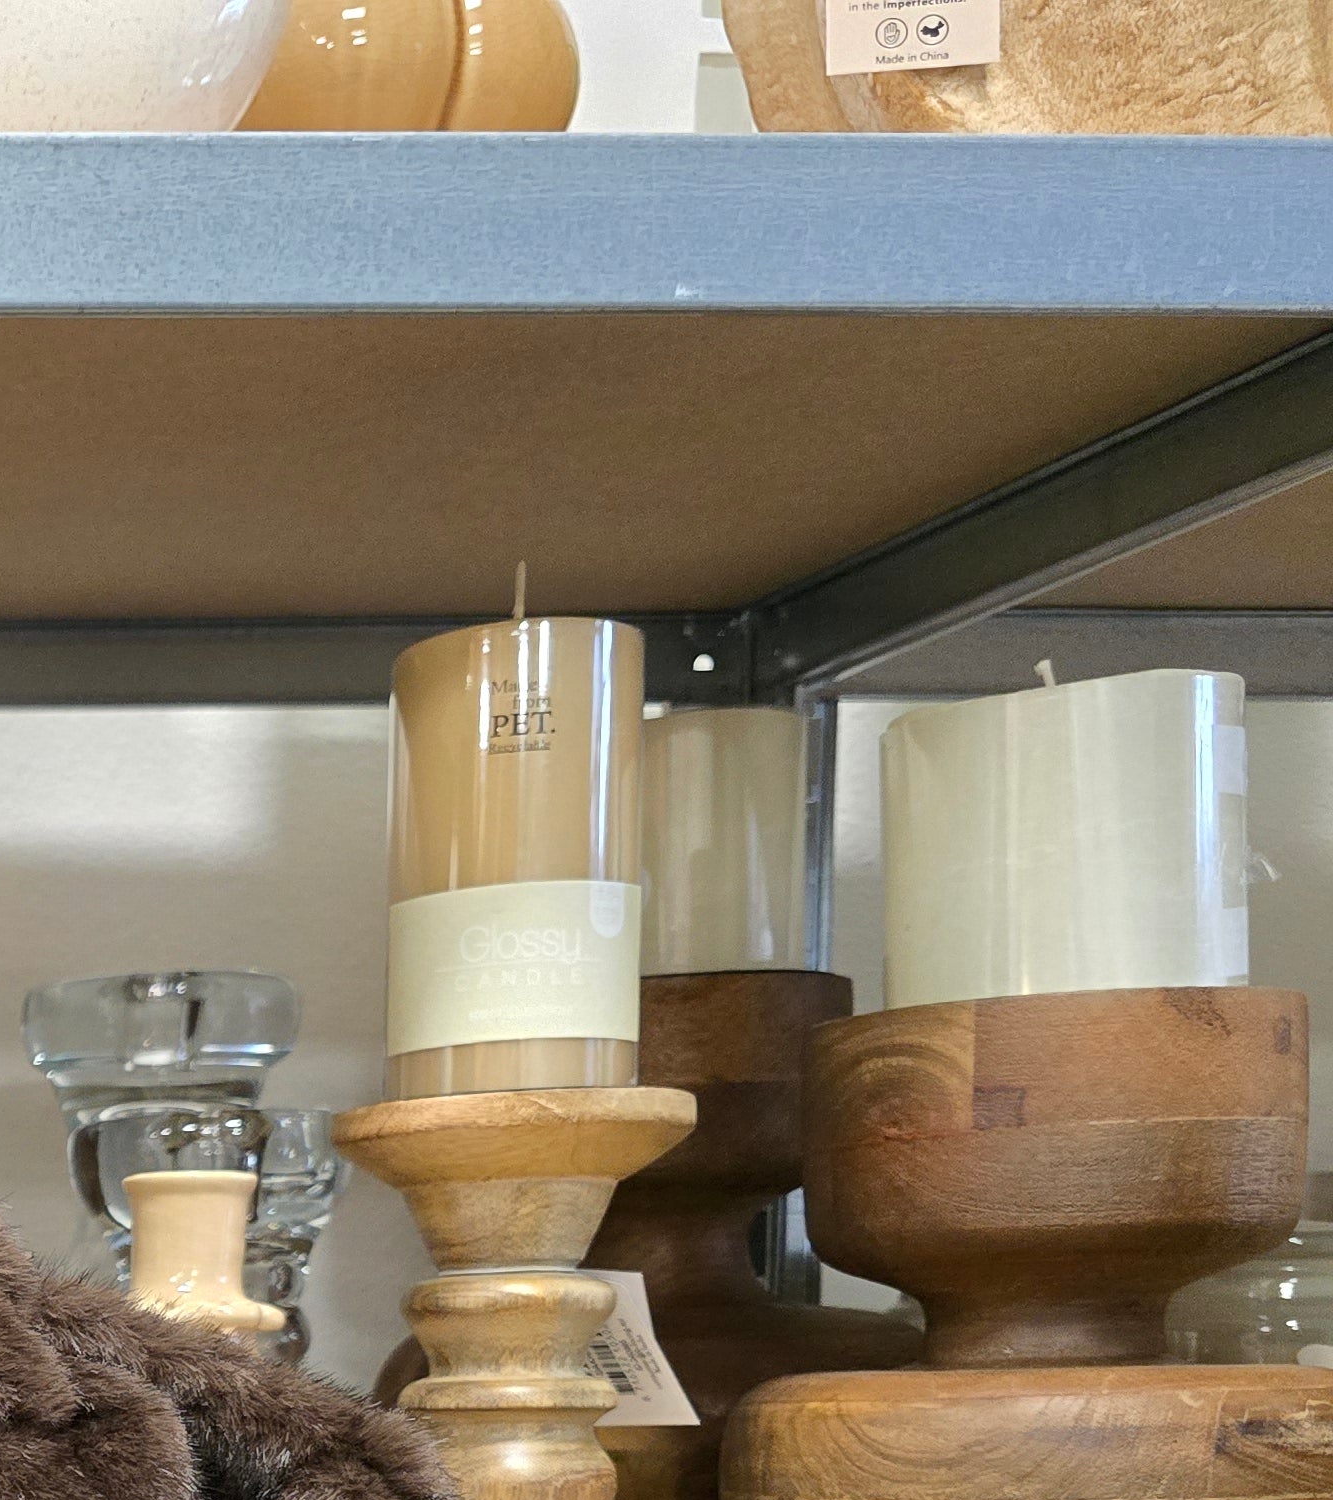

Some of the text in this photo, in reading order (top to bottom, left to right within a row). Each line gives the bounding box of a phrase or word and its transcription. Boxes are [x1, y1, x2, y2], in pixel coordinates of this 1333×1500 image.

[848, 3, 860, 12] in
[863, 2, 881, 11] the
[875, 50, 950, 65] Made in China
[491, 680, 538, 696] Mae
